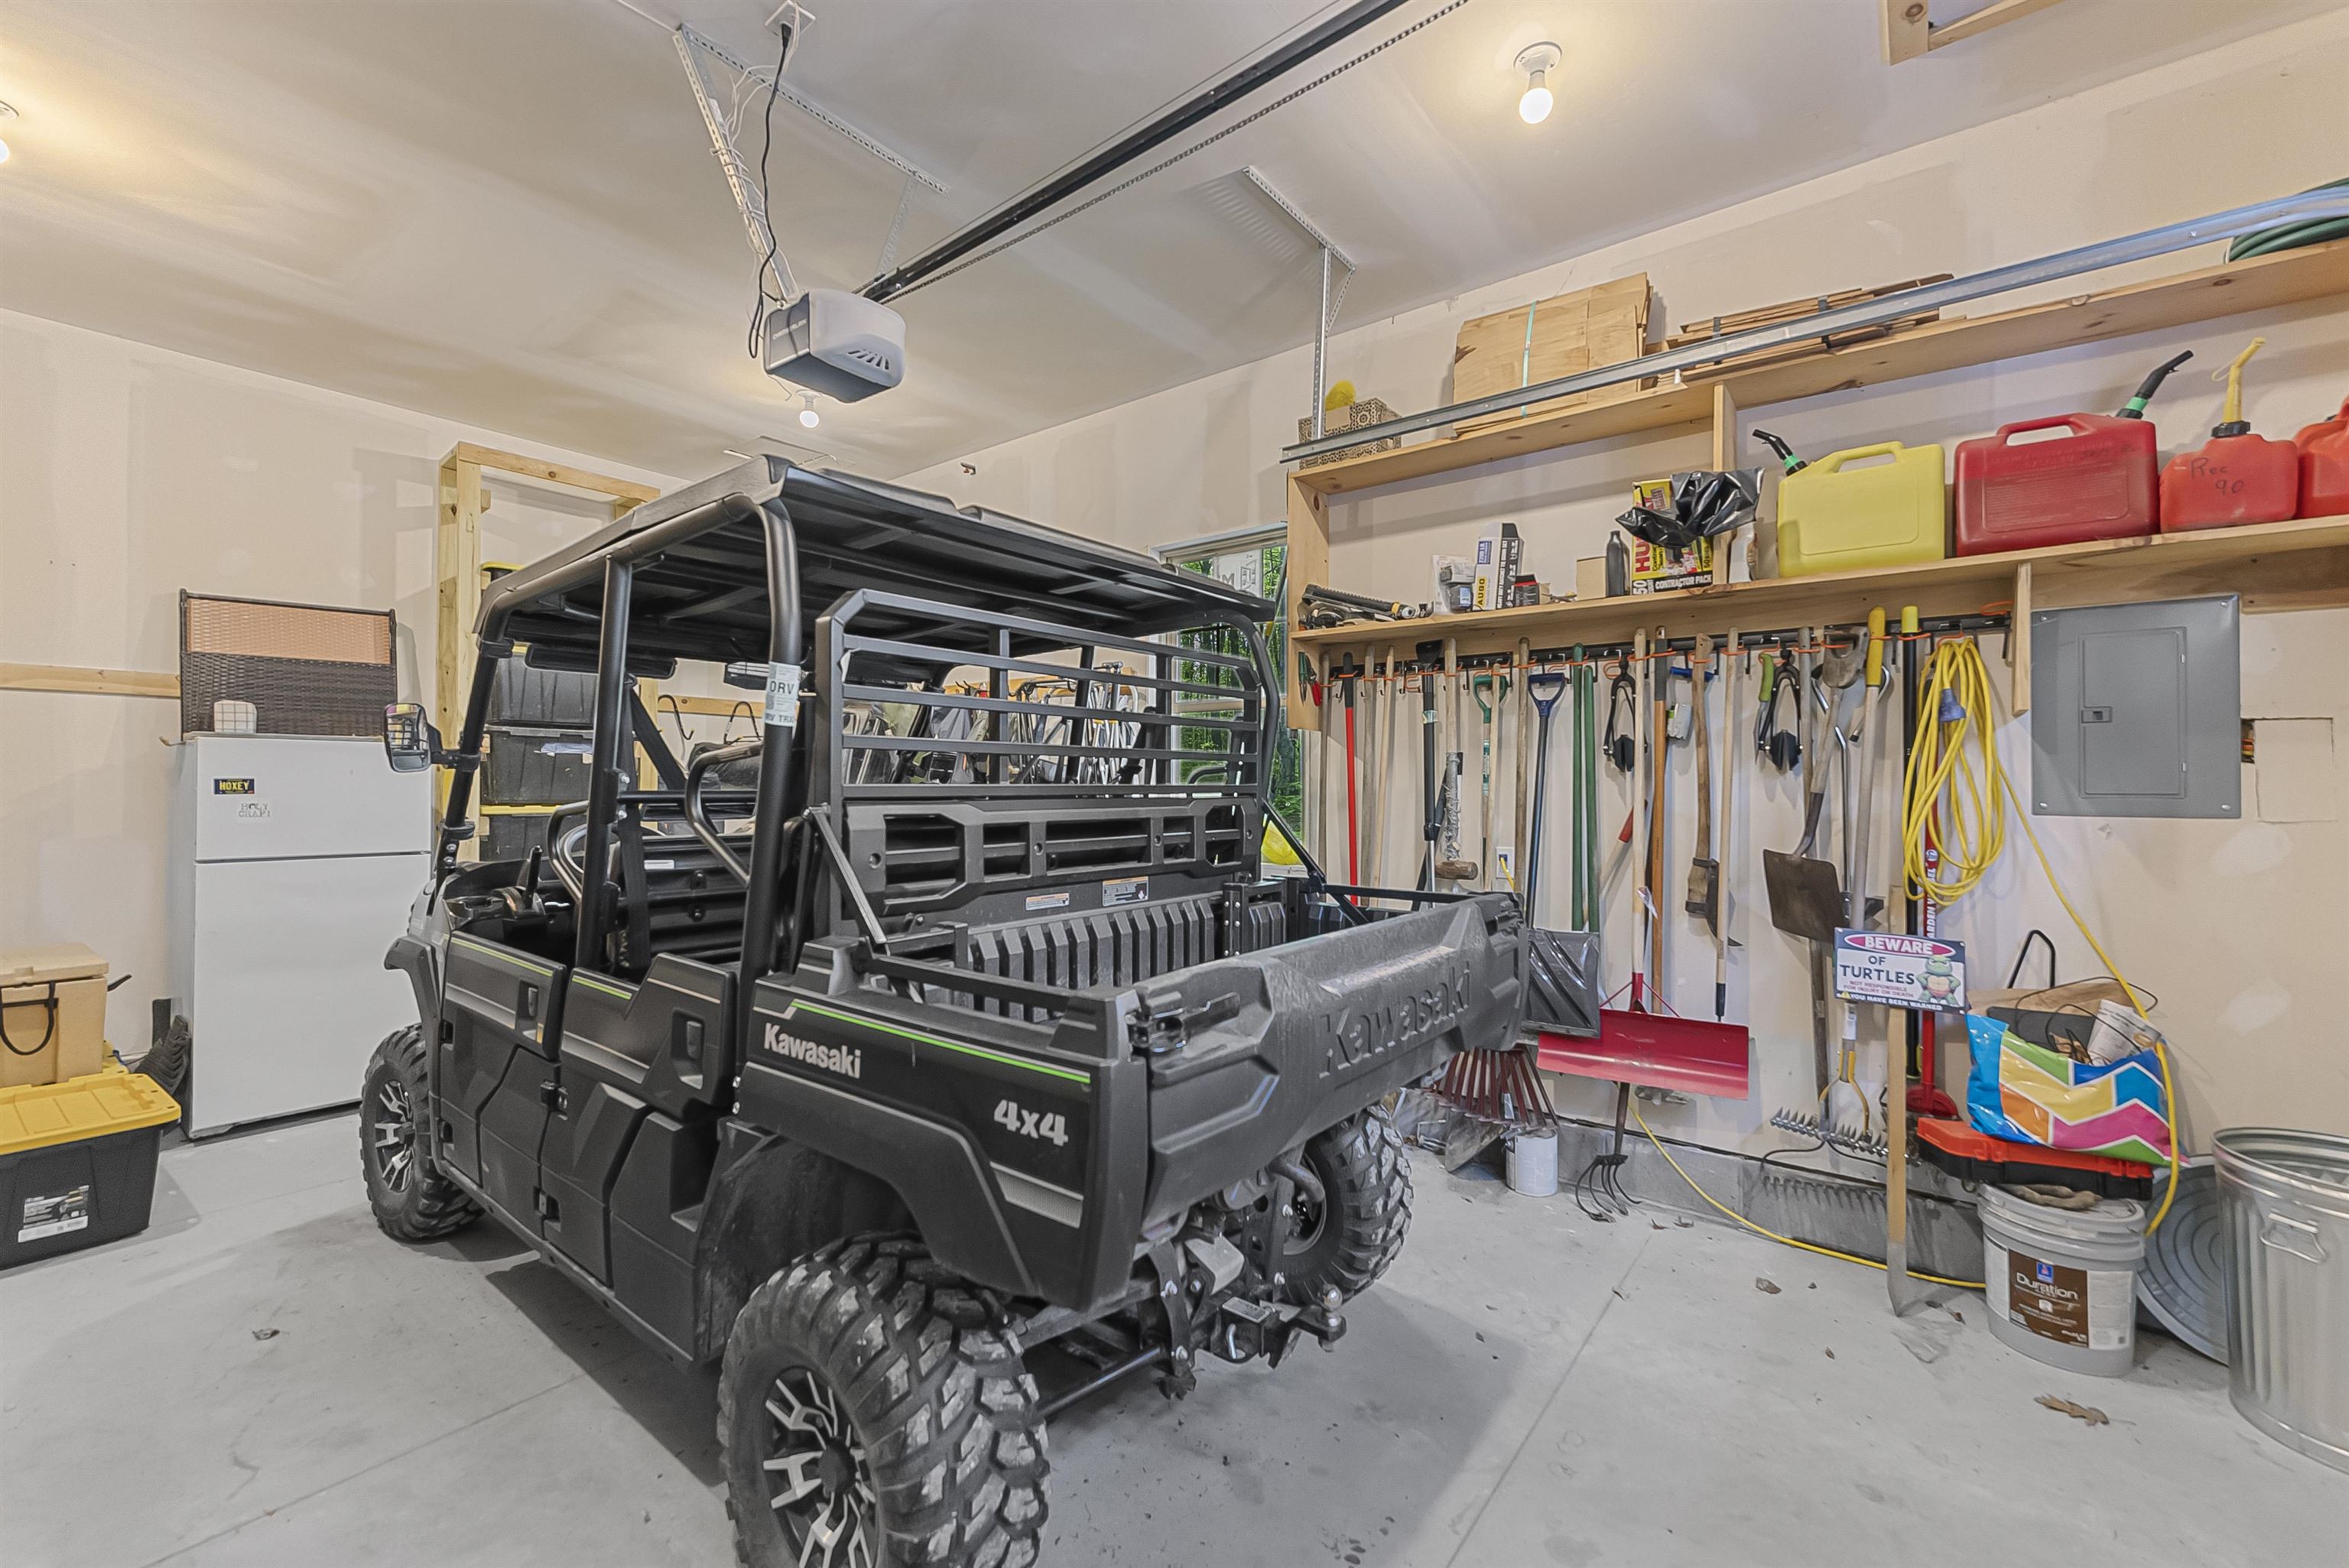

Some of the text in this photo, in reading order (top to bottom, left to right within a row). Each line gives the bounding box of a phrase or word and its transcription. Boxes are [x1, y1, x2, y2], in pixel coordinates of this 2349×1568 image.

[1633, 579, 1648, 595] 50
[1695, 574, 1712, 585] PACK
[769, 680, 794, 695] ORV
[219, 781, 250, 790] HOXEY
[1926, 906, 1936, 939] ARDEN
[1864, 936, 1934, 955] BEWARE
[1868, 956, 1886, 966] OF
[1839, 964, 1915, 985] TURTLES
[1857, 985, 1880, 994] INJURY
[1892, 989, 1914, 998] DEATH
[1864, 982, 1908, 992] RESPONSIBLE
[1867, 995, 1888, 1004] HAVE
[1889, 998, 1909, 1006] BEEN
[1909, 1001, 1943, 1011] WARNED
[1319, 960, 1470, 1079] Kawasaki
[764, 1022, 861, 1079] Kawasaki
[993, 1099, 1069, 1146] 4x4
[2016, 1271, 2078, 1300] Duration
